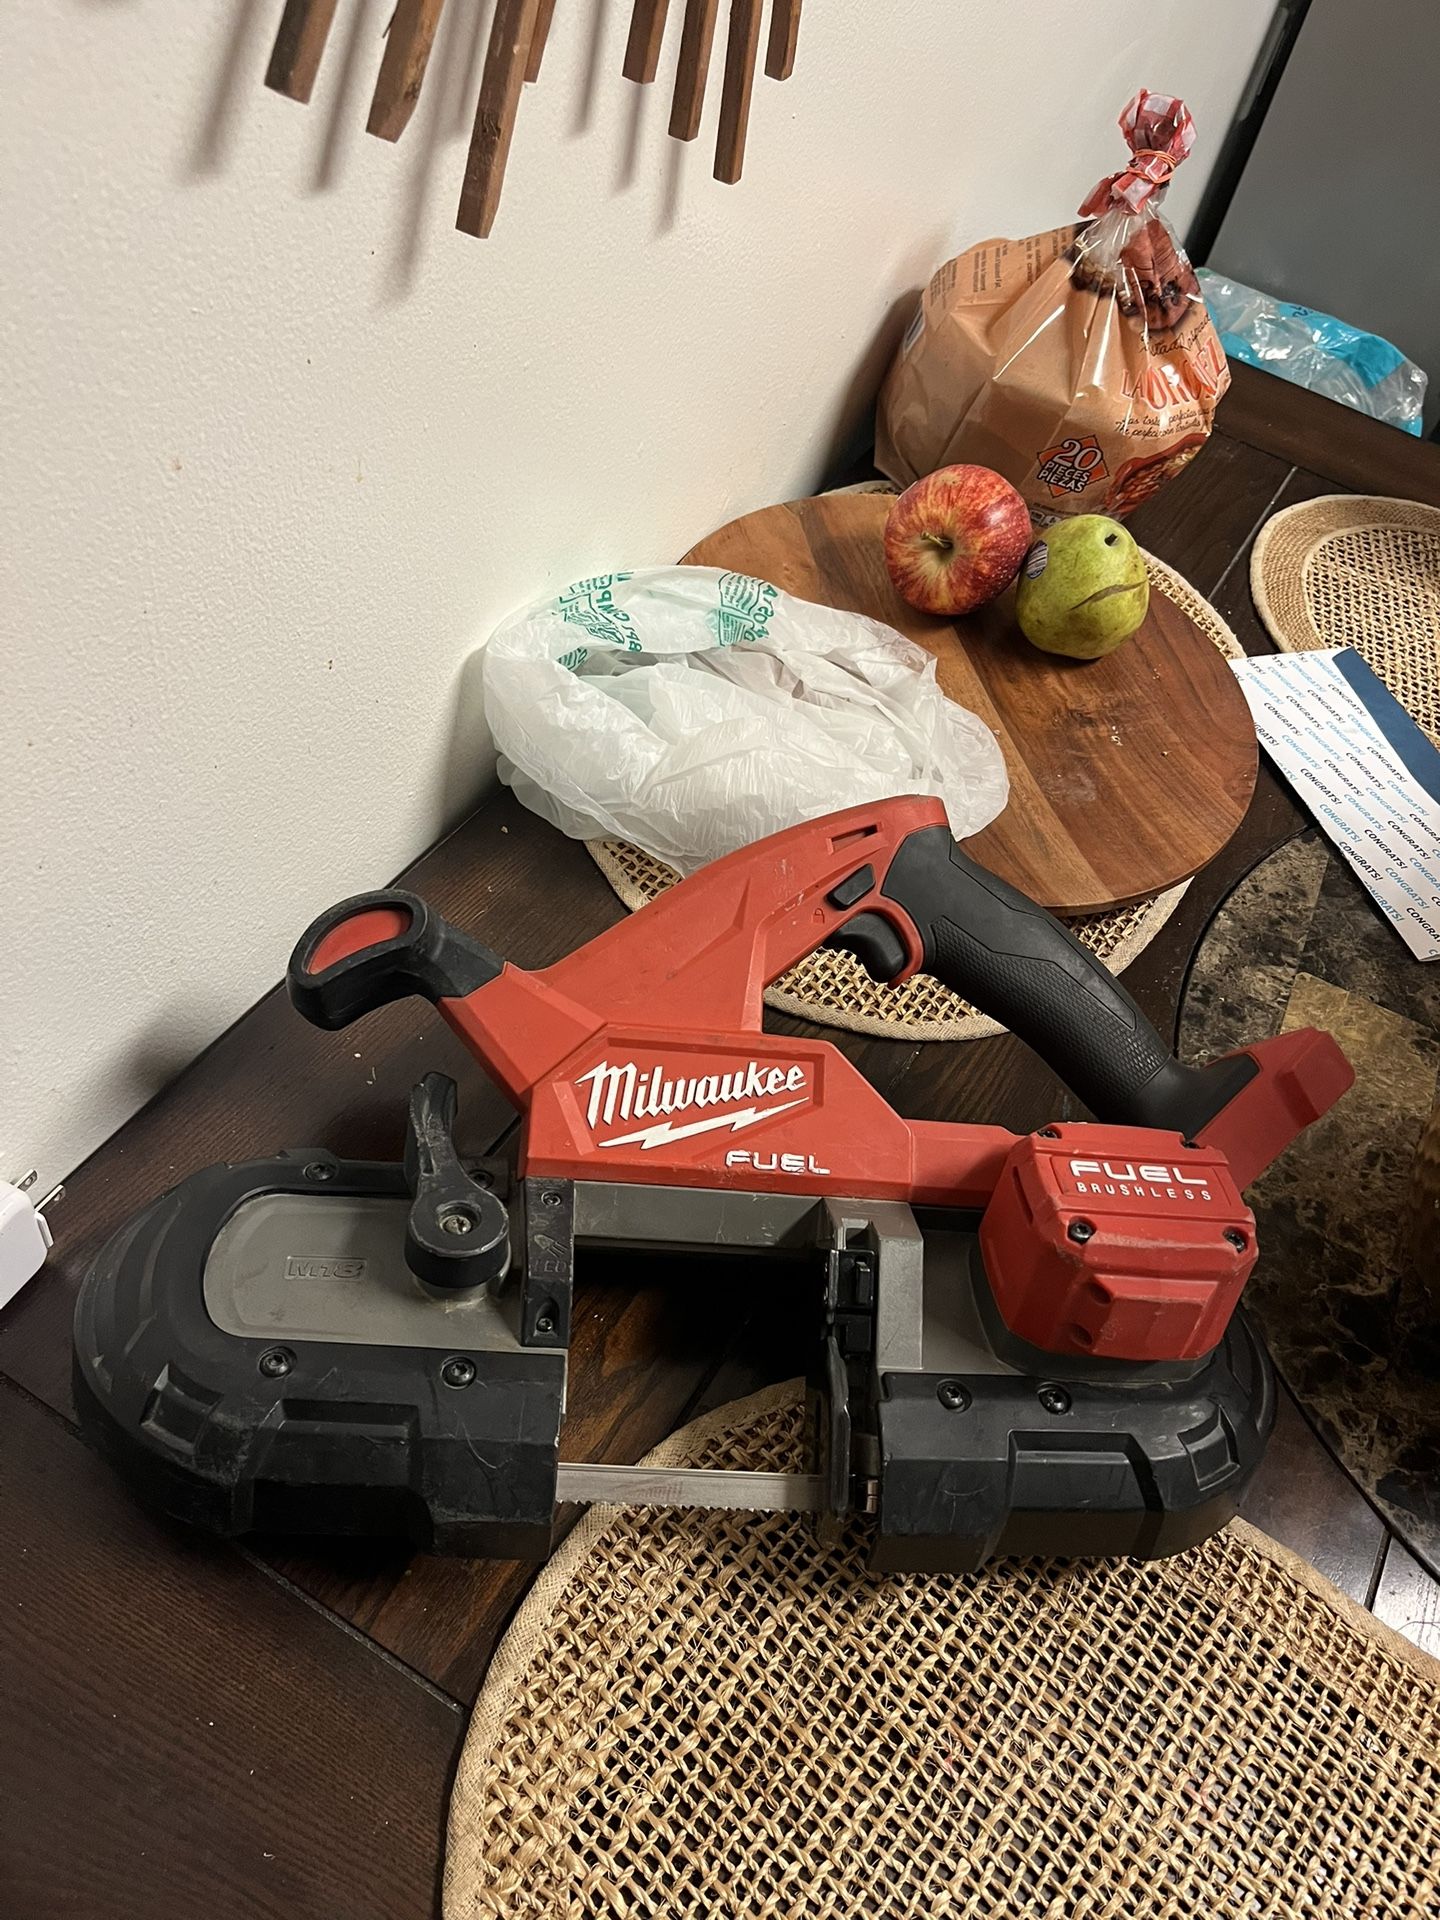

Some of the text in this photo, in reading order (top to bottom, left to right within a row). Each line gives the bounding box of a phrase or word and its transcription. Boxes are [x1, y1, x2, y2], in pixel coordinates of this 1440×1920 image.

[1044, 460, 1091, 482] PIECES
[1052, 439, 1103, 471] 20
[1038, 469, 1086, 492] PIEZAS
[1289, 660, 1326, 692] CONGRATS!
[1310, 654, 1346, 687] CONGRATS!
[1286, 695, 1324, 730] CONGRATS!
[1307, 689, 1346, 724] CONGRATS!
[1328, 683, 1367, 717] CONGRATS!
[1264, 702, 1303, 737] CONGRATS!
[1347, 713, 1387, 750] CONGRATS!
[1282, 734, 1322, 770] CONGRATS!
[1304, 727, 1345, 762] CONGRATS!
[1326, 720, 1366, 755] CONGRATS!
[1324, 759, 1364, 797] CONGRATS!
[1346, 752, 1386, 790] CONGRATS!
[1366, 746, 1408, 783] CONGRATS!
[1300, 768, 1342, 805] CONGRATS!
[1387, 780, 1430, 816] CONGRATS!
[1344, 794, 1386, 832] CONGRATS!
[1365, 787, 1409, 824] CONGRATS!
[1320, 804, 1362, 843] CONGRATS!
[1388, 820, 1431, 860] CONGRATS!
[1339, 841, 1384, 881] CONGRATS!
[1364, 829, 1408, 869] CONGRATS!
[1385, 867, 1430, 909] CONGRATS!
[574, 1060, 807, 1131] Milwaukee
[725, 1149, 831, 1176] FUEL
[1069, 1160, 1208, 1186] FUEL
[1076, 1181, 1212, 1201] BRUSHLESS
[287, 1260, 364, 1279] M18
